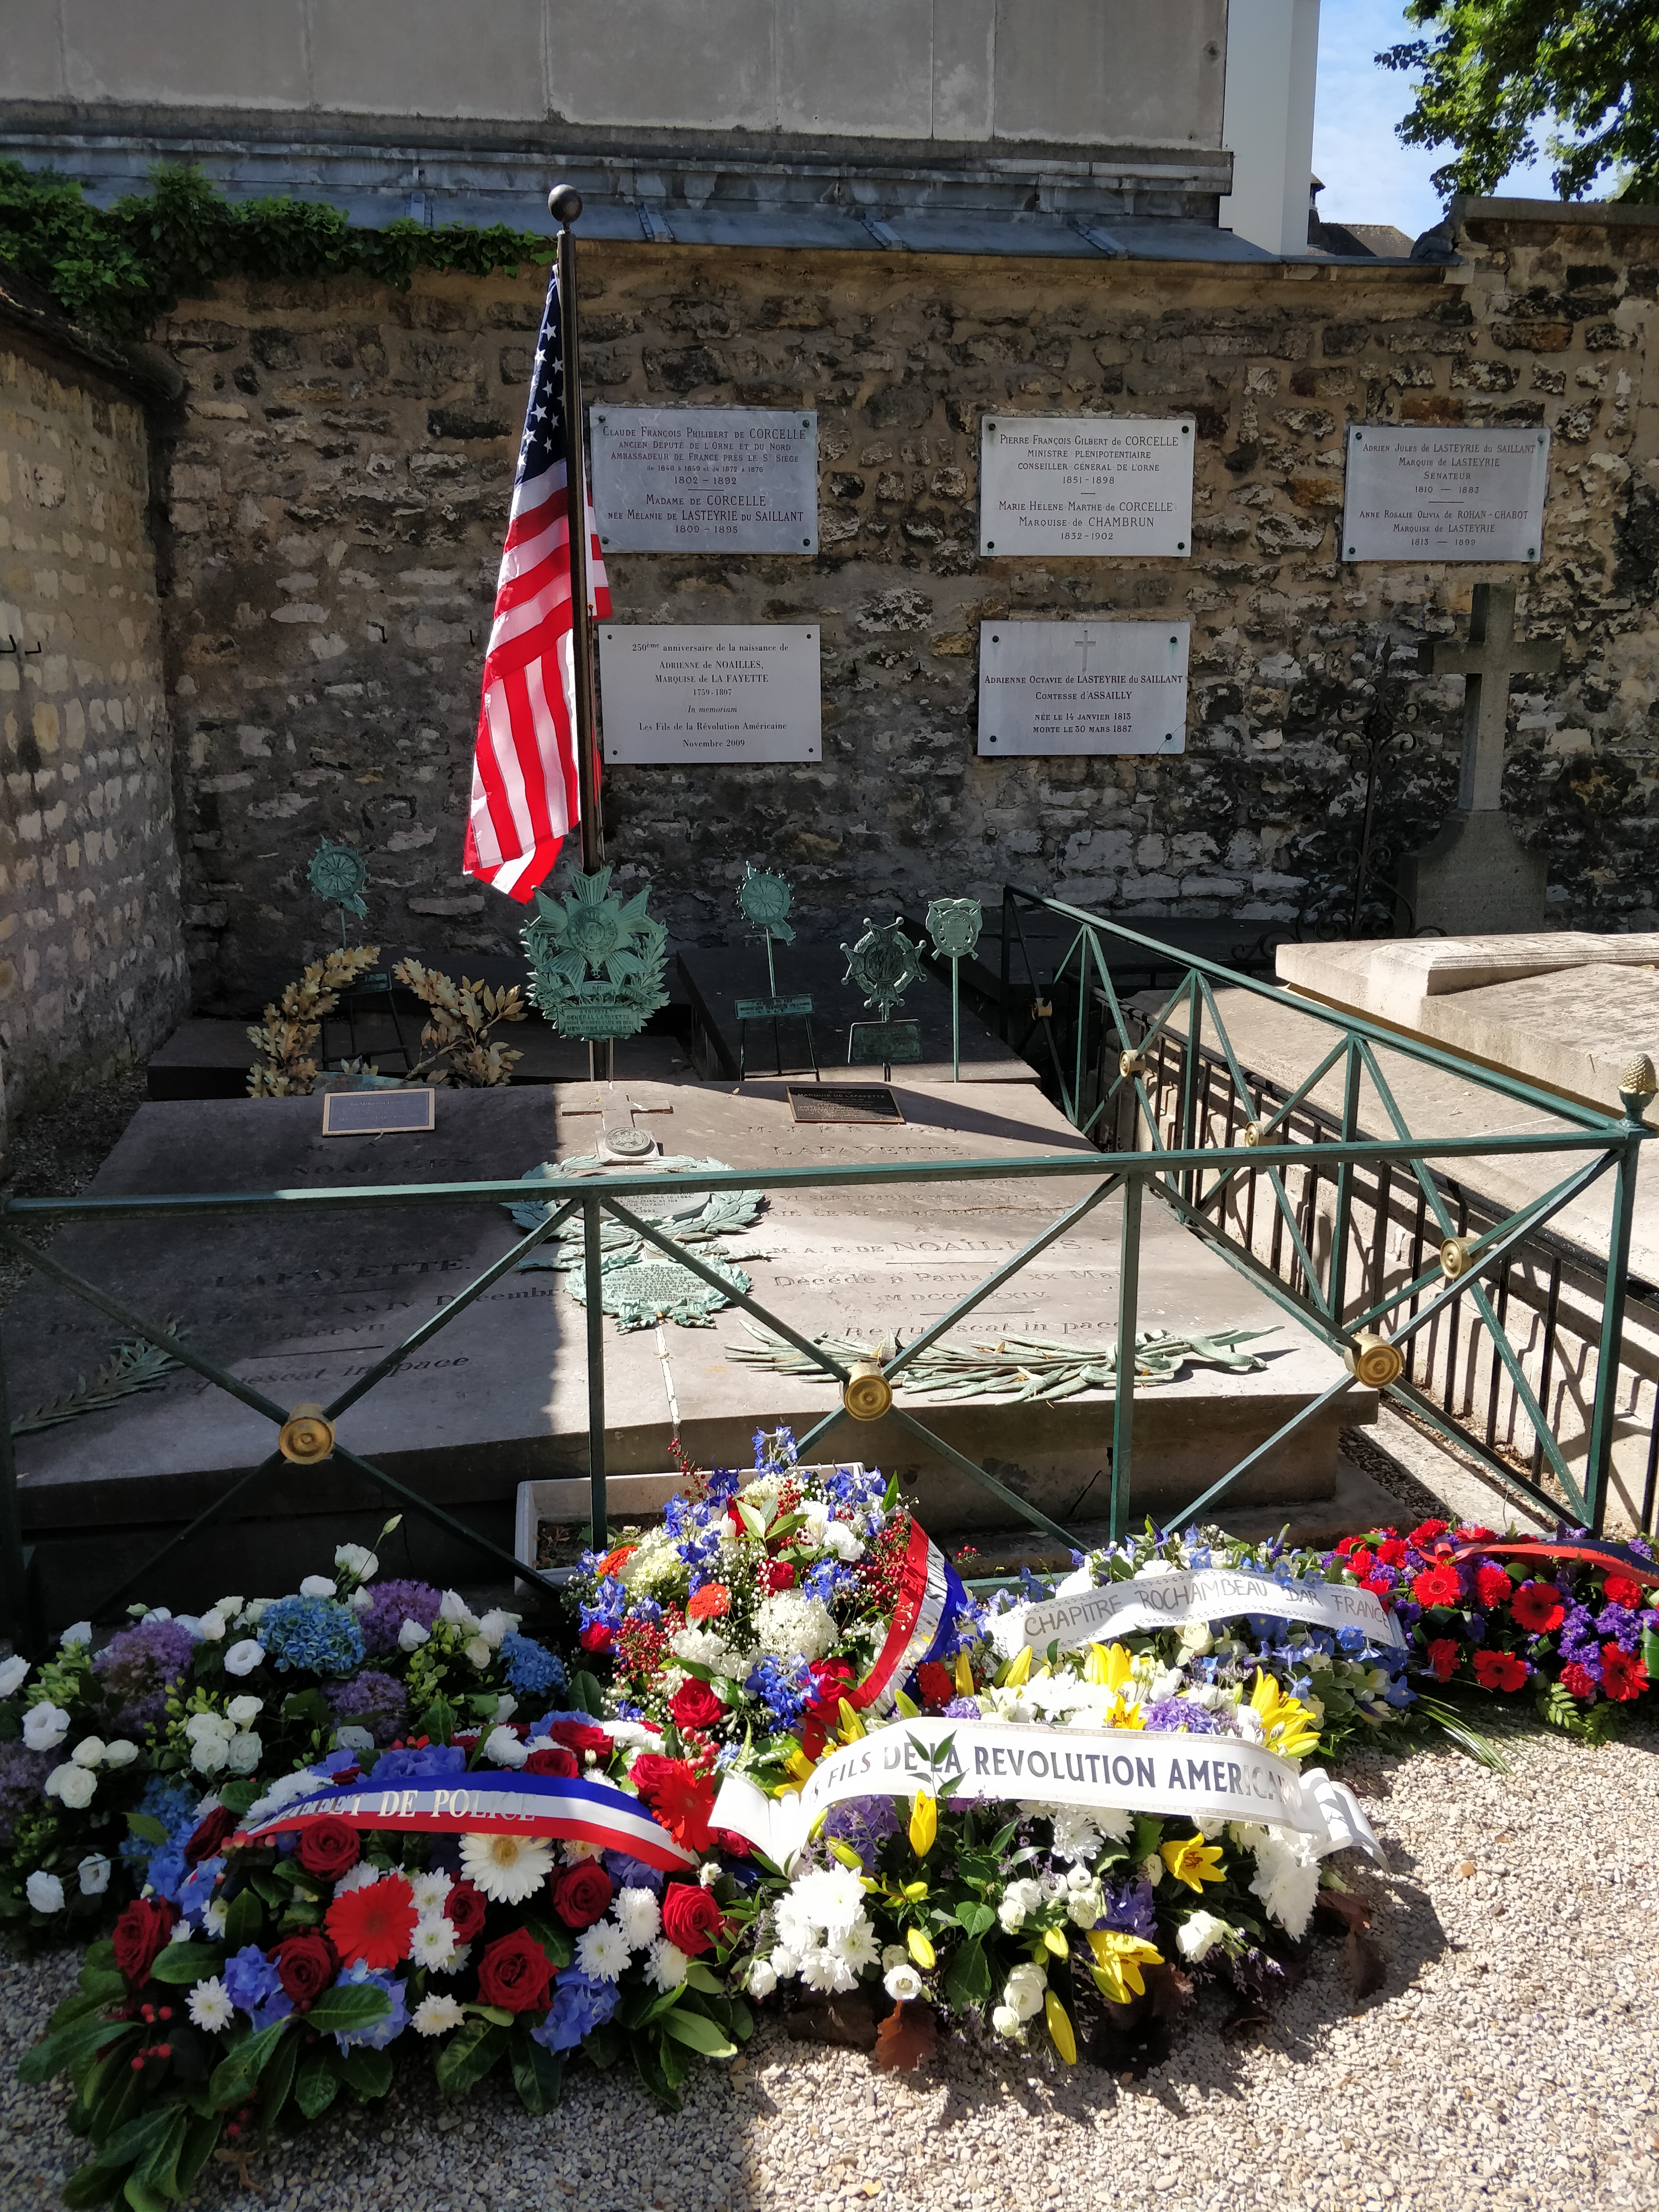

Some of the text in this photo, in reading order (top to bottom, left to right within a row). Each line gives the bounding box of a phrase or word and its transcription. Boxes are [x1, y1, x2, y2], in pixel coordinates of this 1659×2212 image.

[603, 425, 636, 436] CLAUDE
[641, 426, 681, 438] FRANÇOIS
[686, 427, 728, 438] PHILIBERT
[749, 427, 805, 439] CORCELLE
[1000, 434, 1178, 445] PIERRE FRANÇOIS GILBERT de CORCELLE
[1395, 443, 1417, 451] JULES
[1421, 444, 1430, 452] de
[1433, 444, 1480, 452] LASTEYRIE
[1497, 444, 1536, 453] SAILLANT
[1075, 449, 1151, 458] PLÉNIPOTENTIAIRE
[1074, 462, 1112, 470] GÉNÉRAL
[1399, 457, 1500, 467] MARQUIS de LASTEYRIE
[1424, 471, 1471, 480] SÉNATEUR
[646, 494, 684, 505] MADAME
[707, 495, 766, 506] CORCELLE
[999, 501, 1025, 510] MARIE
[1068, 501, 1102, 510] MARTHE
[1106, 503, 1115, 511] de
[1119, 502, 1173, 511] CORCELLE
[627, 508, 662, 520] MÉLANIE
[682, 510, 738, 520] LASTEYRIE
[756, 511, 804, 521] SAILLANT
[1384, 510, 1413, 518] ROSALIE
[1019, 516, 1154, 527] MARQUISE de CHAMBRUN
[1393, 524, 1430, 533] MARQUISE
[1448, 524, 1495, 532] LASTEYRIE
[703, 661, 712, 669] de
[716, 661, 763, 669] NOAILLES,
[655, 674, 696, 684] MARQUISE
[727, 674, 769, 682] FAYETTE
[985, 675, 1026, 683] ADRIENNE
[1129, 675, 1138, 683] du
[1141, 675, 1183, 683] SAILLANT
[1035, 691, 1132, 699] COMTESSE d'ASSAILLY
[885, 1239, 1094, 1252] NOAILLS.
[913, 1271, 983, 1282] Paris
[1024, 1578, 1391, 1637] CHAPITRE ROCHAMBEAU DAR FRANCE
[828, 1752, 870, 1788] FILS
[884, 1743, 917, 1770] DE
[929, 1743, 962, 1773] LA
[974, 1745, 1156, 1789] REVOLUTION
[377, 1790, 418, 1818] DE
[430, 1789, 536, 1822] POLICE
